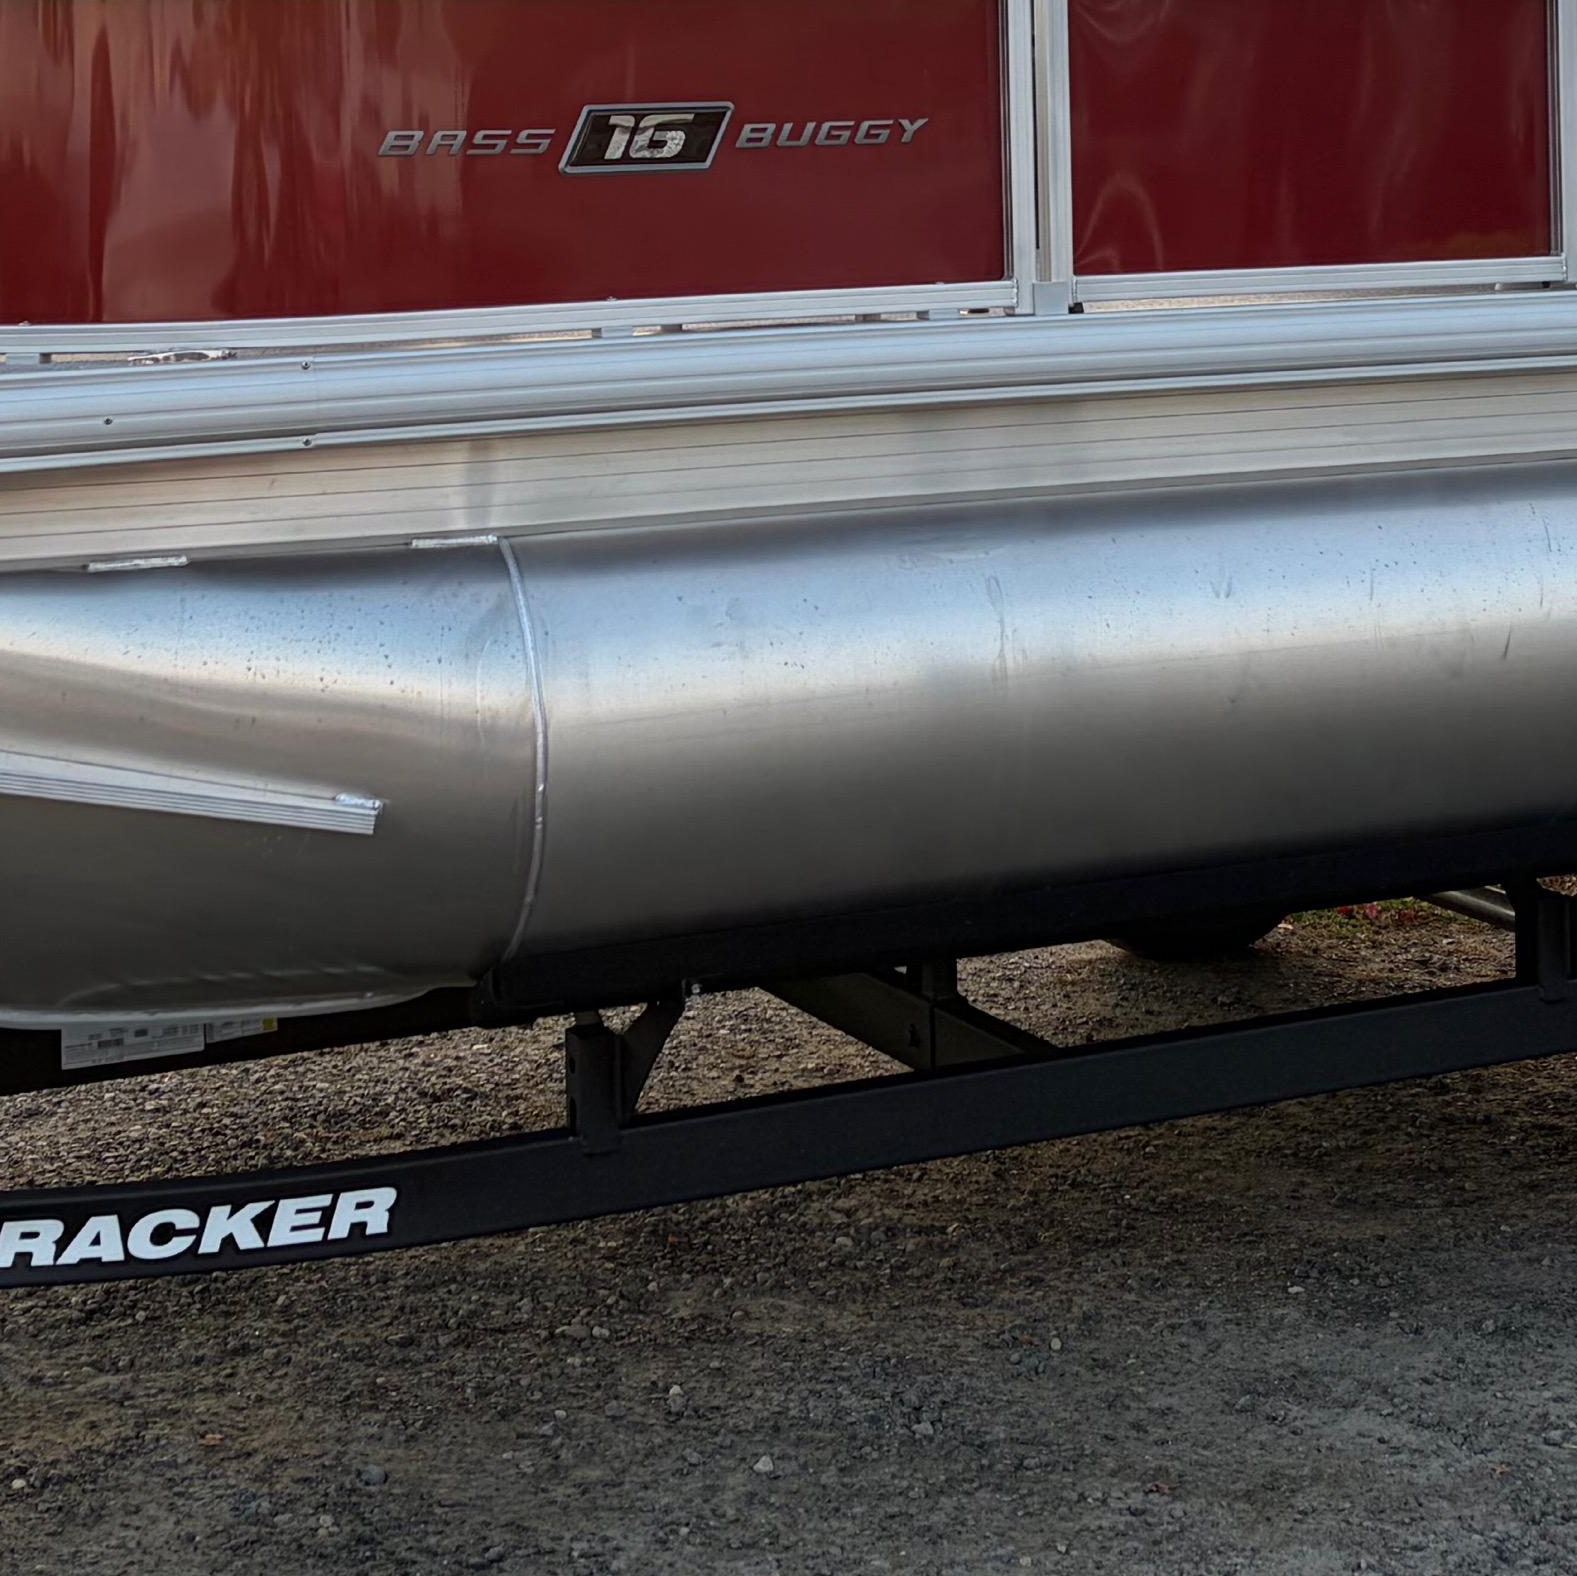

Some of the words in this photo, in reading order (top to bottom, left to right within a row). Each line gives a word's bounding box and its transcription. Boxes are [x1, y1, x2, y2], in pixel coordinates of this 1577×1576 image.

[377, 128, 557, 158] BASS
[604, 112, 696, 161] 16
[734, 117, 930, 151] BUGGY
